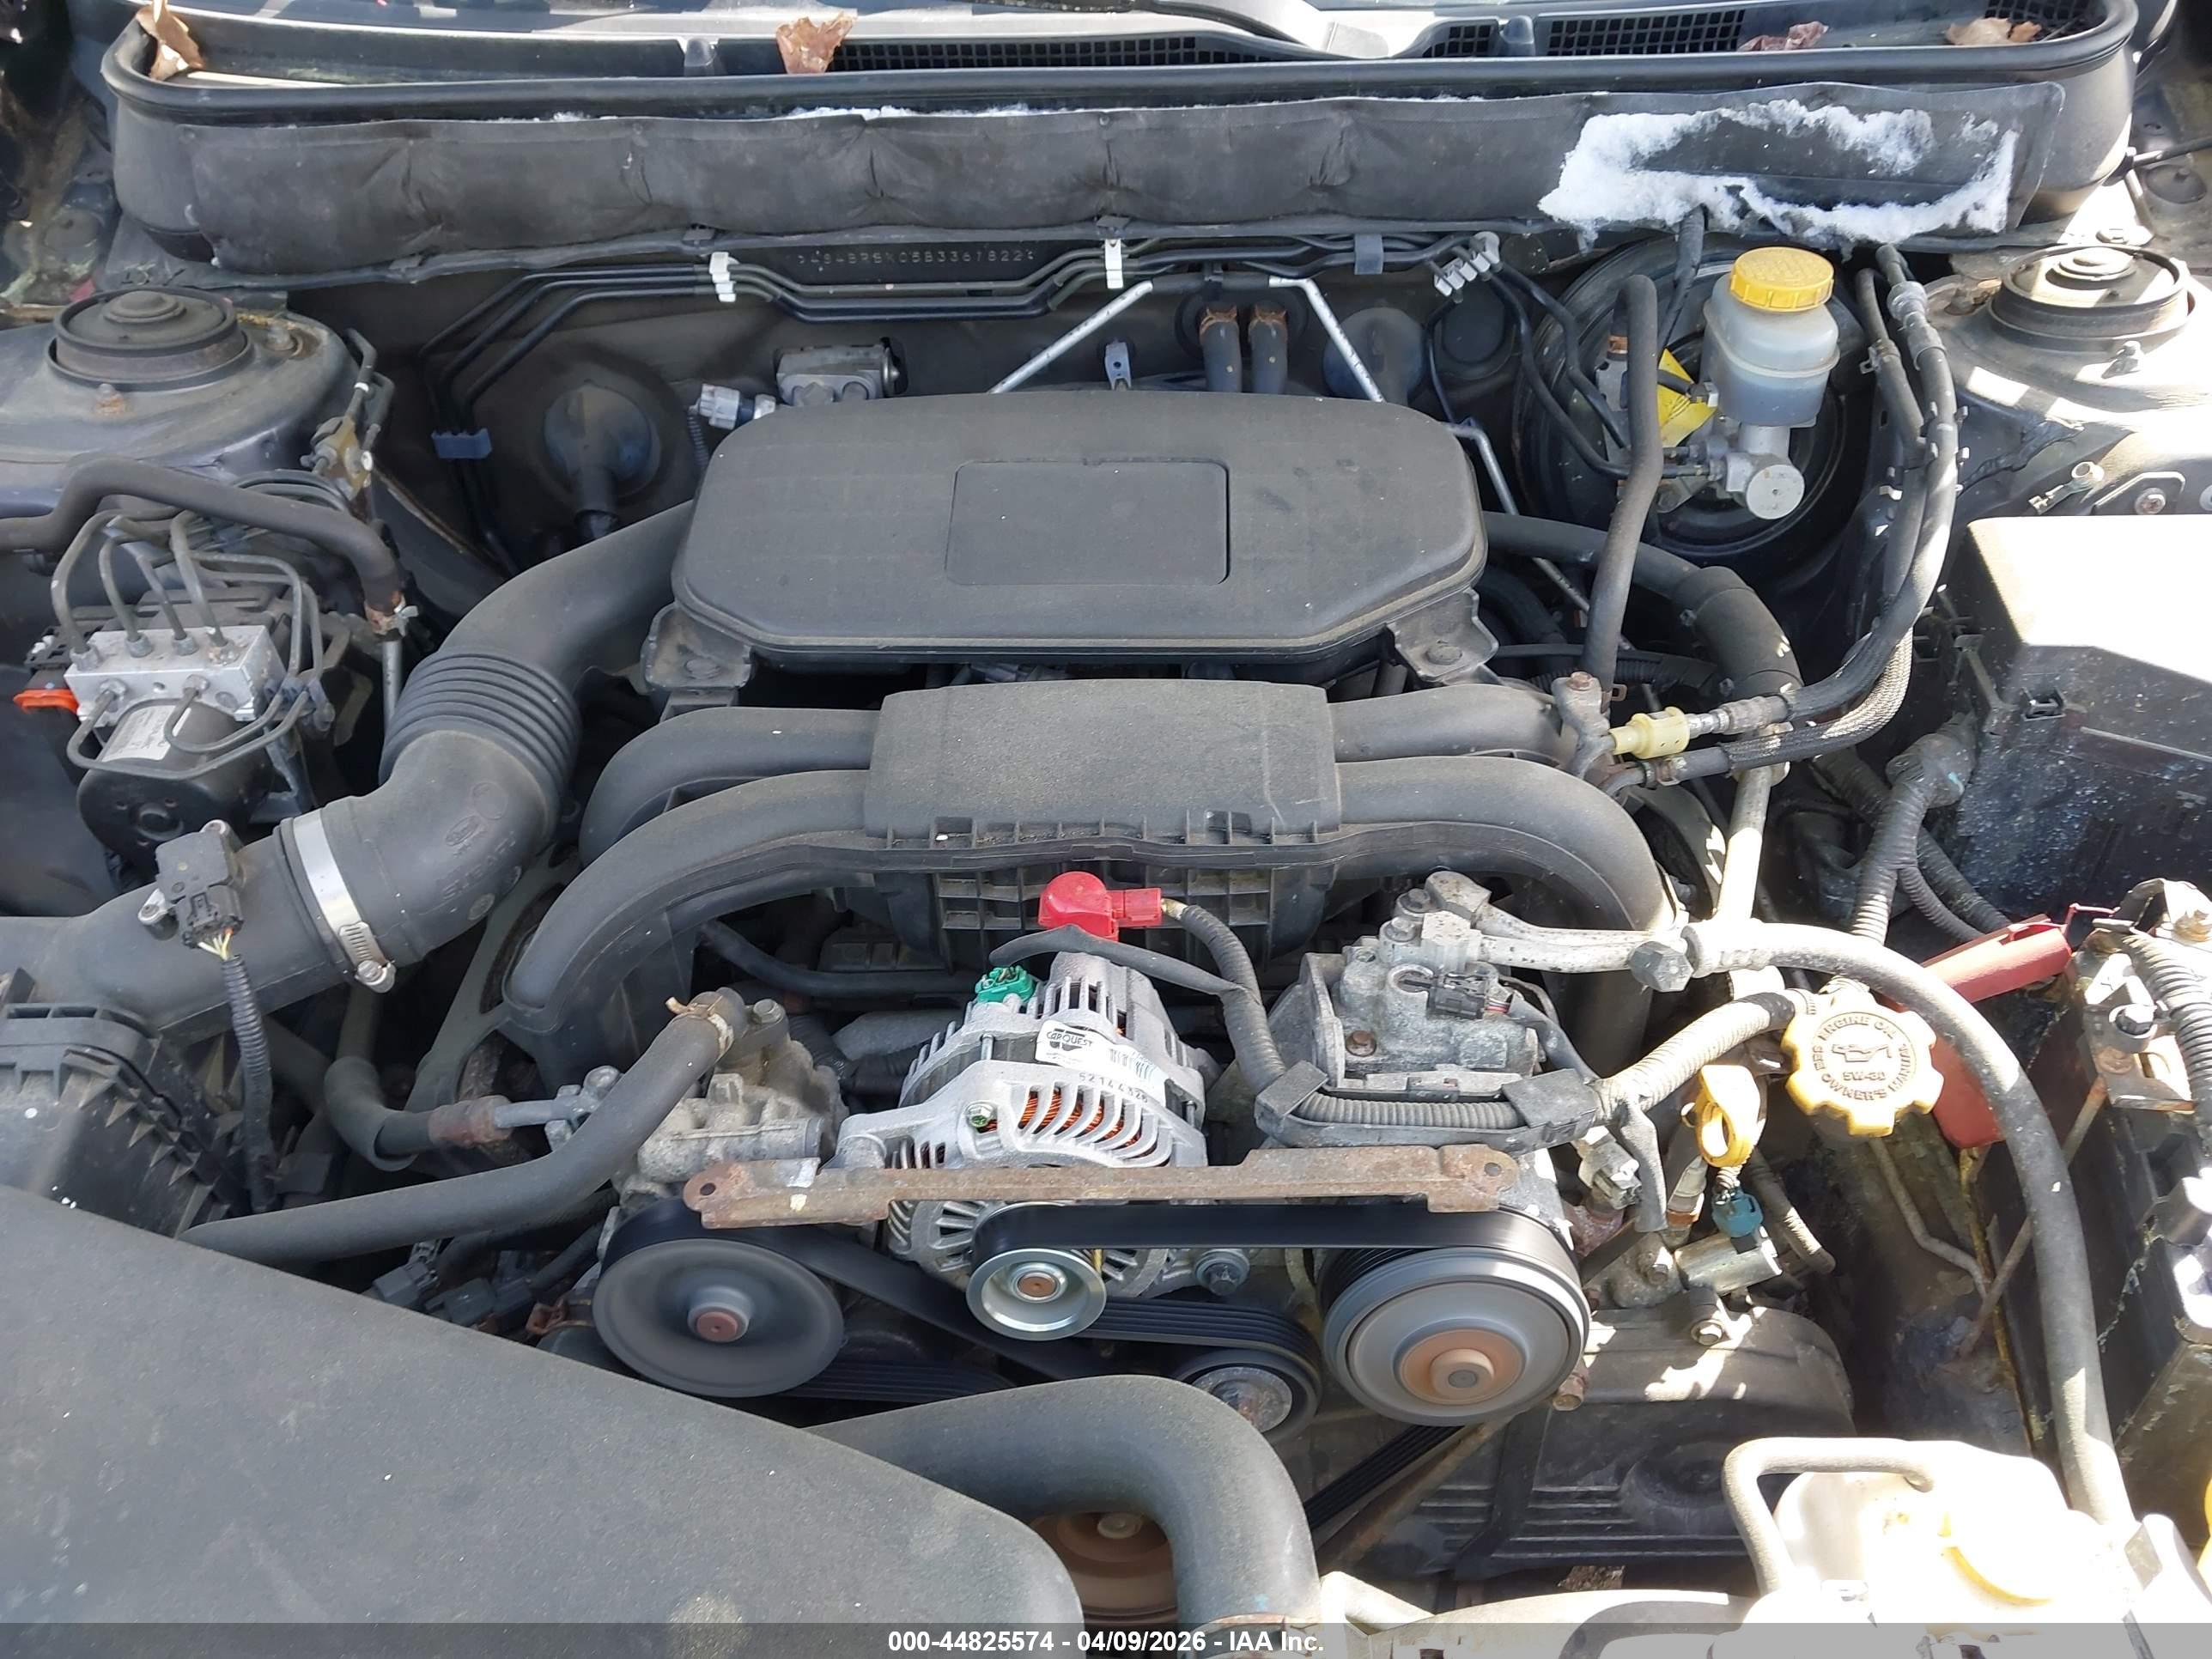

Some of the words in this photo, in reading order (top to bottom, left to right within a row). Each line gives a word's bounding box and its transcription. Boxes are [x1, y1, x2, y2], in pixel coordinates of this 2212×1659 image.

[1818, 1016, 1869, 1041] ENGINE
[1875, 1020, 1897, 1040] OIL
[1812, 1045, 1826, 1071] SEE
